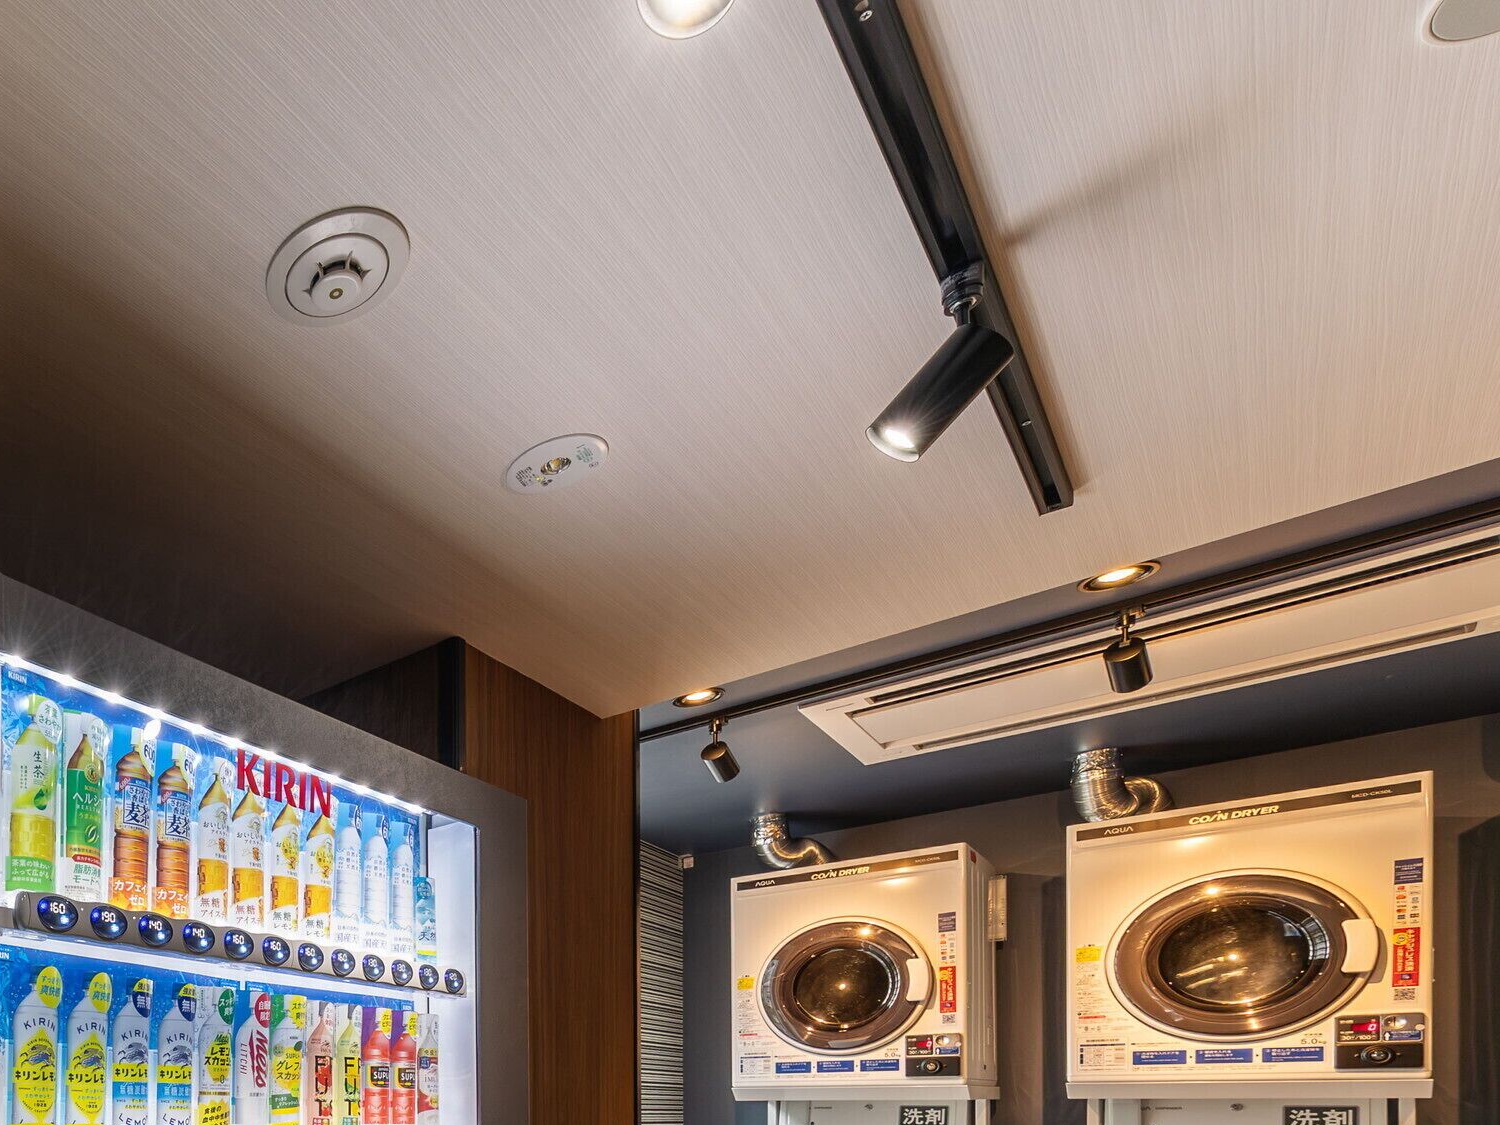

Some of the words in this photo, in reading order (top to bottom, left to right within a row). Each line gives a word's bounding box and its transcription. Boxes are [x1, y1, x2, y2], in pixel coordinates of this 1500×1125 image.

[7, 671, 27, 684] KIRIN
[32, 750, 45, 779] 生茶
[236, 748, 332, 818] KIRIN
[1104, 826, 1133, 835] AQUA
[1189, 810, 1229, 825] COIN
[1230, 805, 1280, 819] DRYER
[755, 879, 776, 888] AQUA
[811, 870, 837, 881] COIN
[838, 866, 870, 877] DRYER
[129, 895, 144, 906] ゼロ
[200, 897, 220, 908] 無糖
[172, 903, 187, 915] ゼロ
[235, 904, 255, 915] 無糖
[272, 911, 291, 921] 無糖
[50, 902, 66, 915] 160
[101, 911, 116, 923] 190
[148, 920, 162, 930] 140
[192, 928, 205, 939] 140
[233, 934, 245, 945] 160
[270, 941, 281, 951] 160
[305, 919, 323, 929] 無糖
[23, 1017, 56, 1032] KIRIN
[76, 1022, 106, 1035] KIRIN
[902, 1107, 946, 1125] 洗剤
